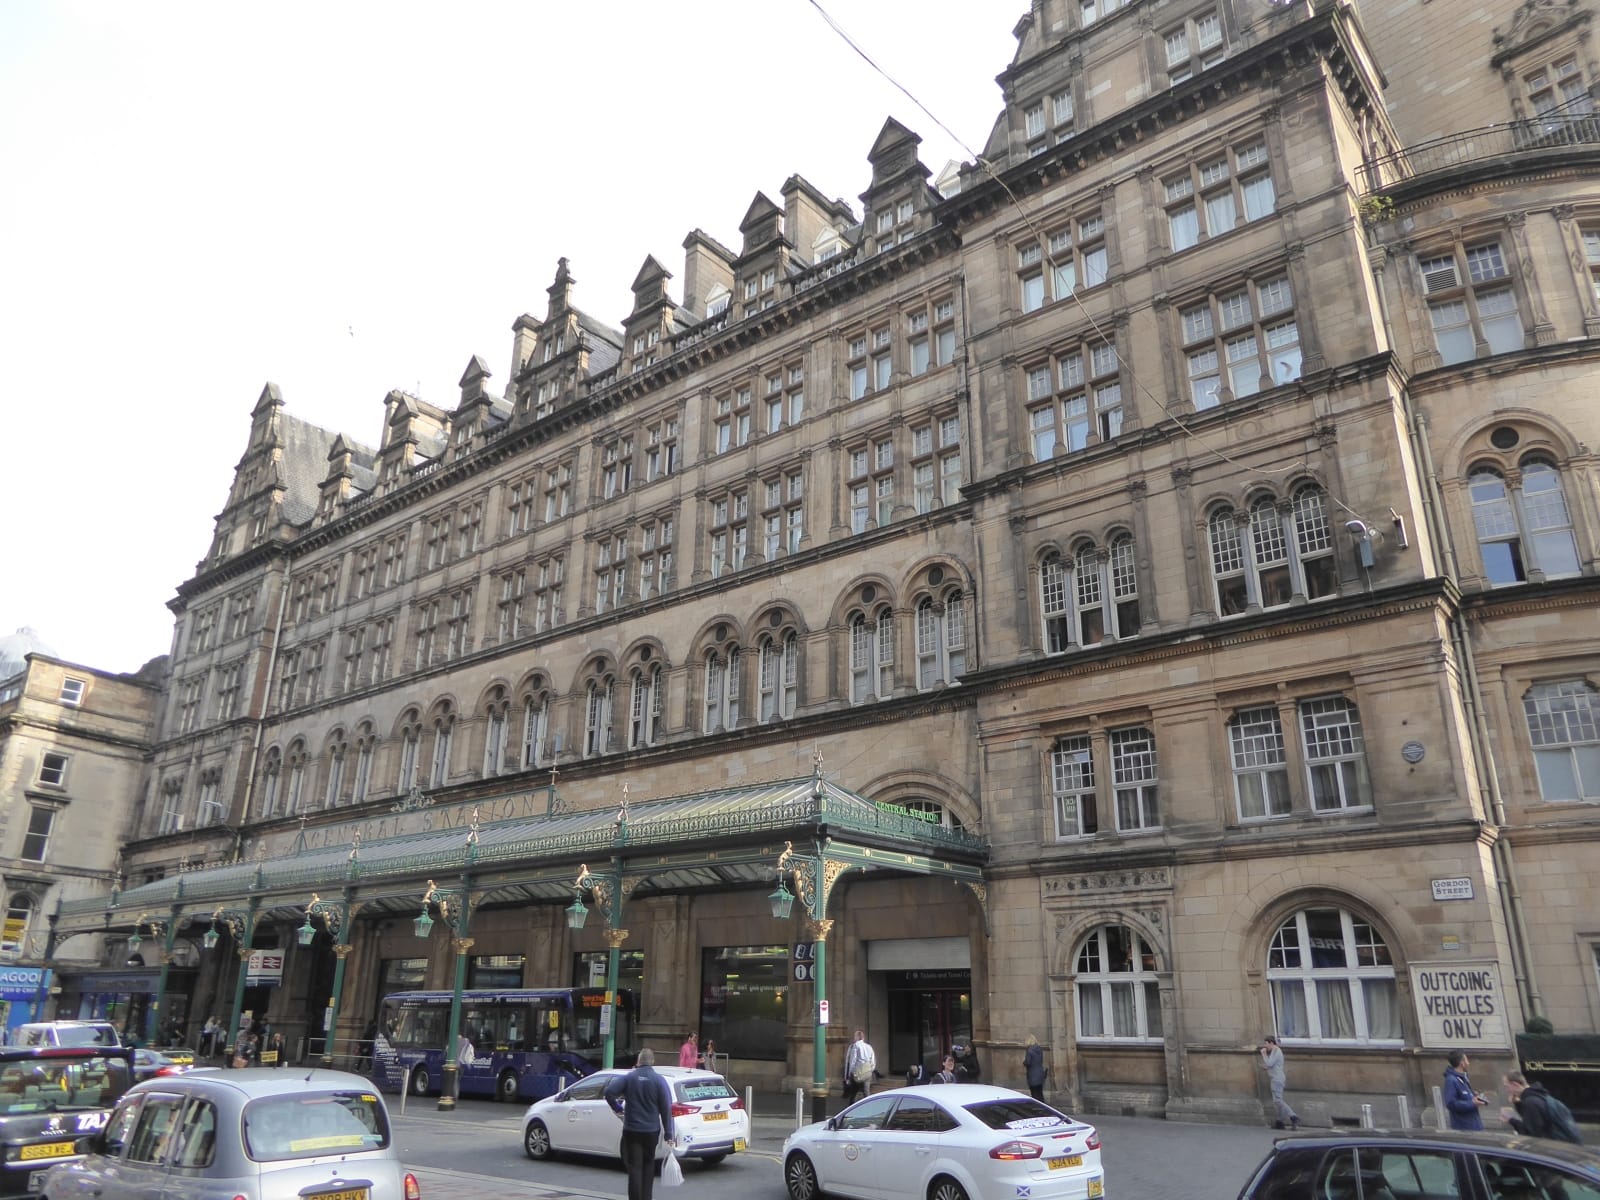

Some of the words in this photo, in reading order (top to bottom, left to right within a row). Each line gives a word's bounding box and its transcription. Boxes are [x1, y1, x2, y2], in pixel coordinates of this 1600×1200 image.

[310, 818, 404, 850] CENTRAL
[423, 794, 535, 831] STATION
[875, 801, 908, 816] CENTRAL
[909, 808, 938, 822] STATION
[1433, 880, 1469, 888] GORDON
[1435, 887, 1470, 895] STREET
[1420, 971, 1493, 992] OUTGOING
[1423, 995, 1495, 1016] VEHICLES
[1443, 1019, 1483, 1039] ONLY
